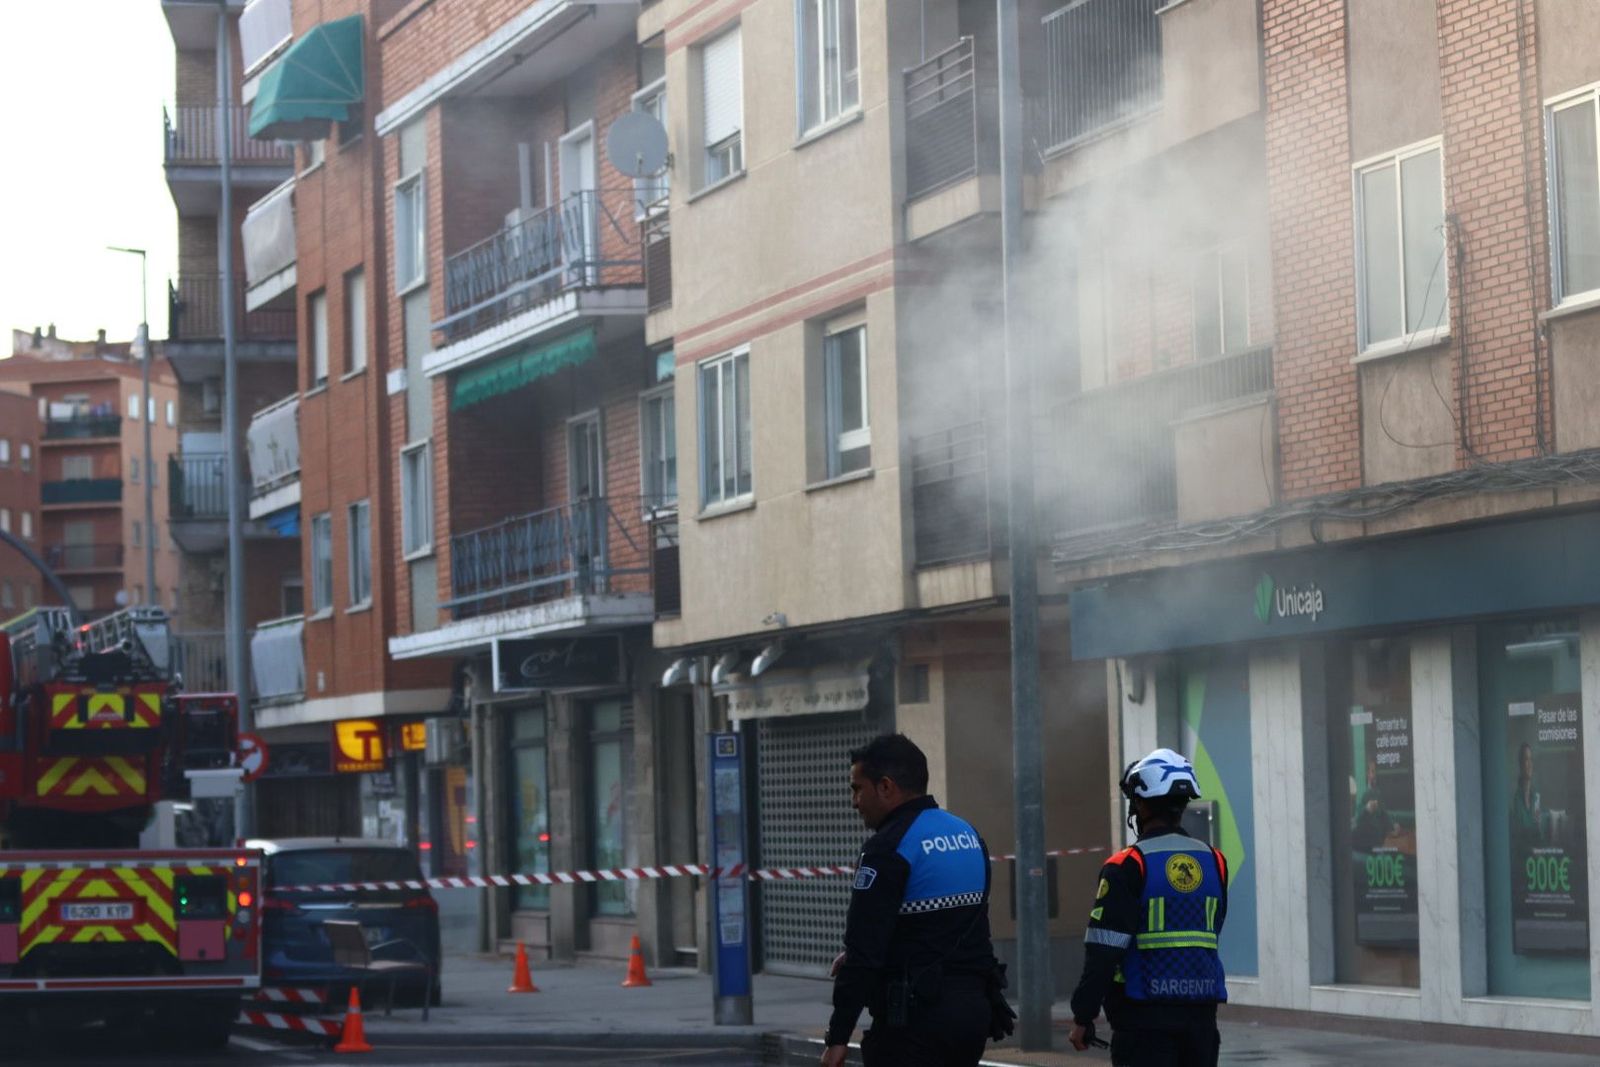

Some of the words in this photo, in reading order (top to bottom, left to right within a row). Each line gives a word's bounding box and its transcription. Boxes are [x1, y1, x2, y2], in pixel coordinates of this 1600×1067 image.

[1276, 583, 1323, 621] Unicaja
[1538, 709, 1556, 723] Pasar
[1557, 709, 1566, 722] de
[1567, 707, 1578, 721] las
[1538, 726, 1577, 741] comisiones
[921, 831, 981, 855] POLICÍA
[1366, 853, 1405, 887] 900€
[1526, 856, 1571, 892] 900€
